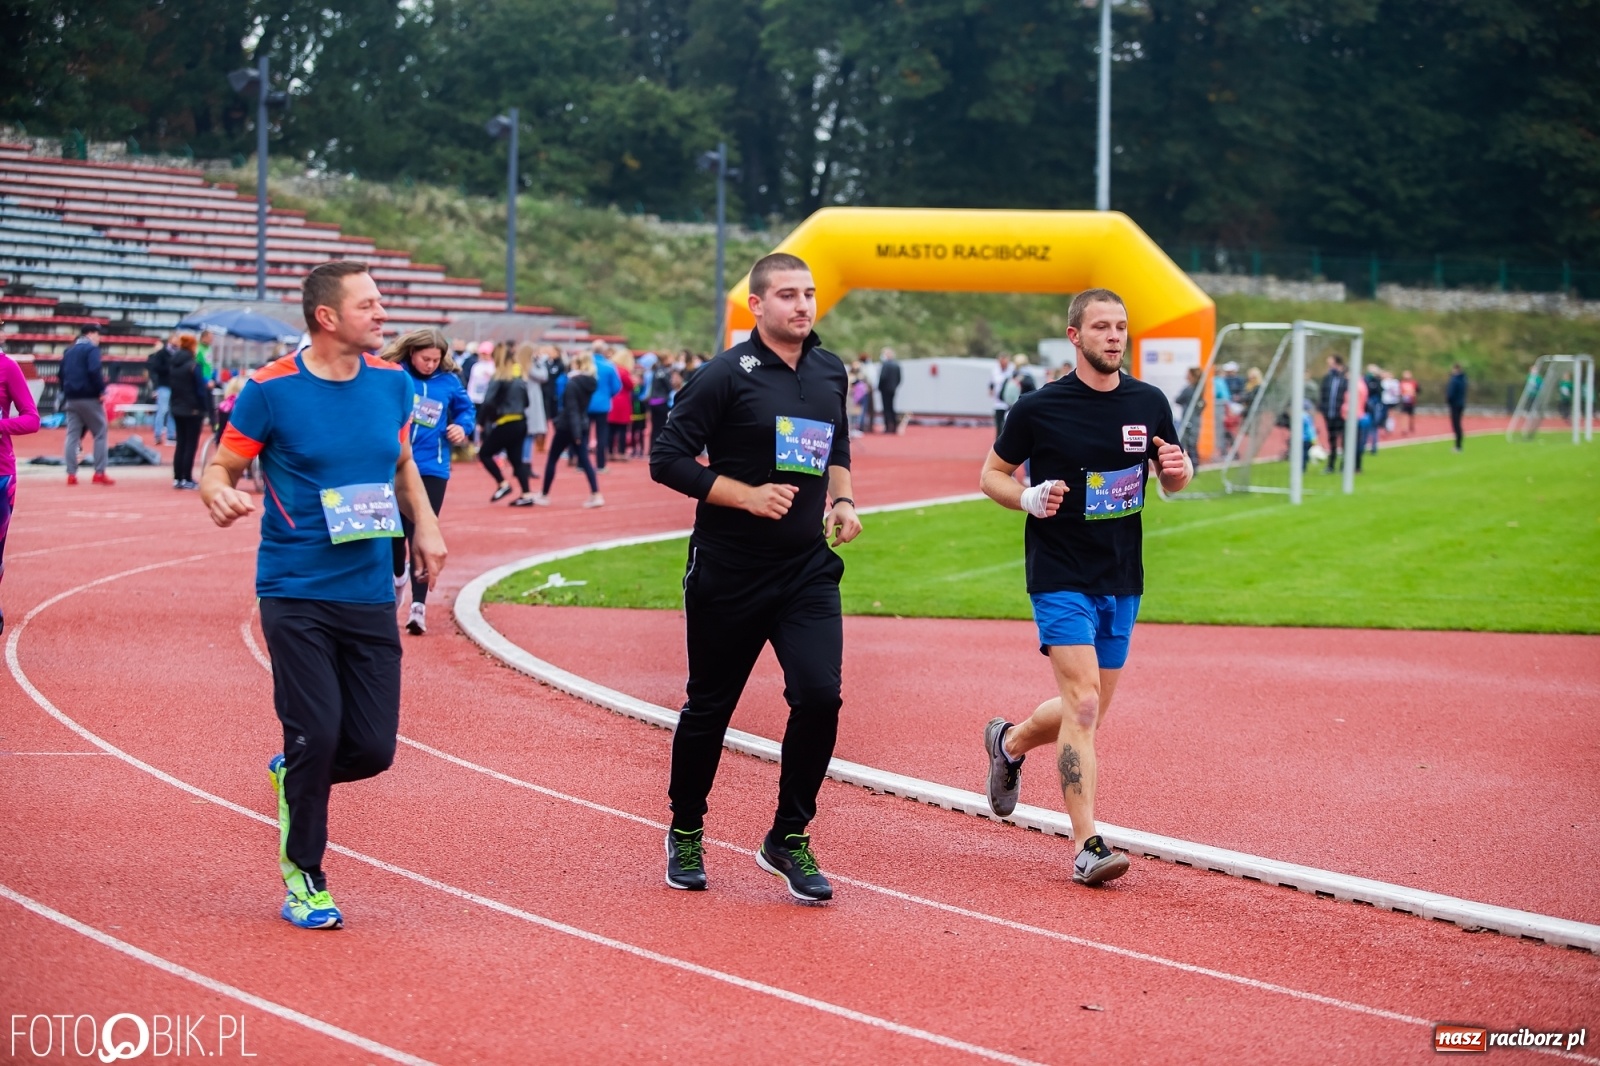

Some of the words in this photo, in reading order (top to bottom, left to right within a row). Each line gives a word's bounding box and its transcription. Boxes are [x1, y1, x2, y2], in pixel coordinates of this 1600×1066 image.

[876, 244, 948, 260] MIASTO
[952, 241, 1051, 261] RACIBÓRZ
[1121, 496, 1138, 510] 054
